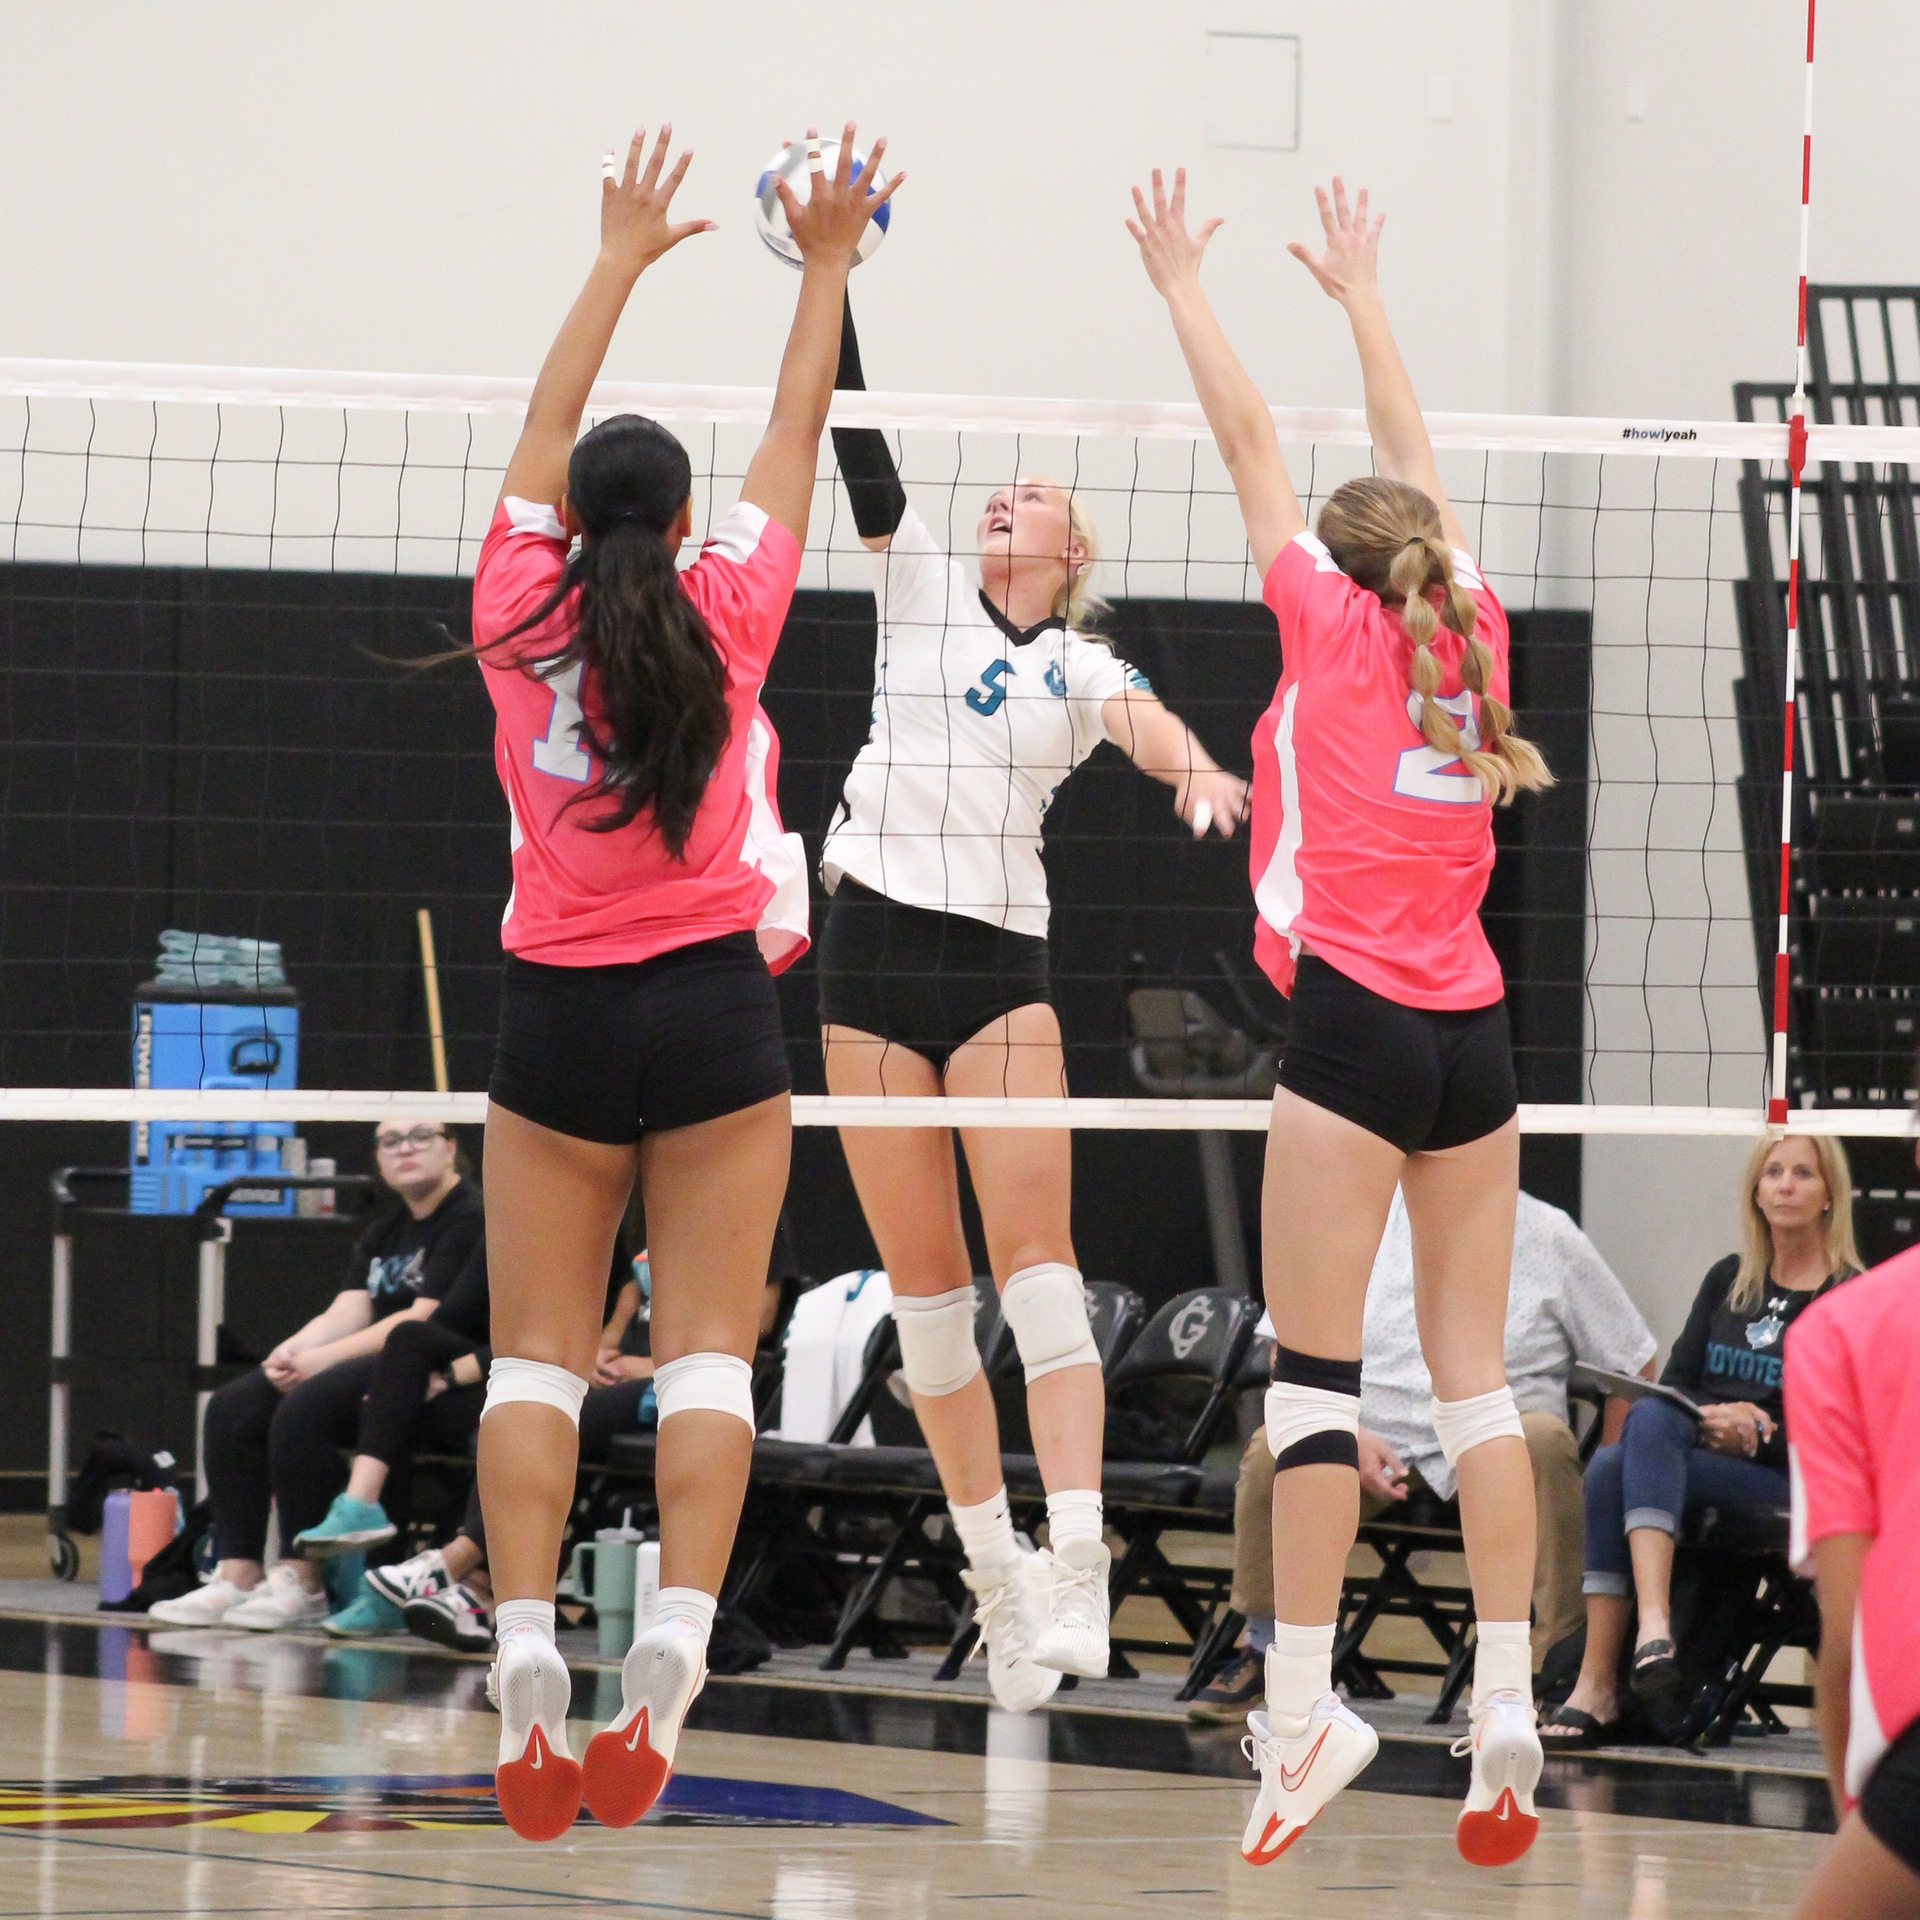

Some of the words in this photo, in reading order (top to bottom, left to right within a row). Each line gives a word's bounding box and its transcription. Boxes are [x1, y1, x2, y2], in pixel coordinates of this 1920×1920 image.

[1622, 428, 1697, 442] #howlyeah
[965, 658, 1018, 717] 5
[1393, 687, 1483, 804] 2
[1706, 1341, 1783, 1388] OYOTE
